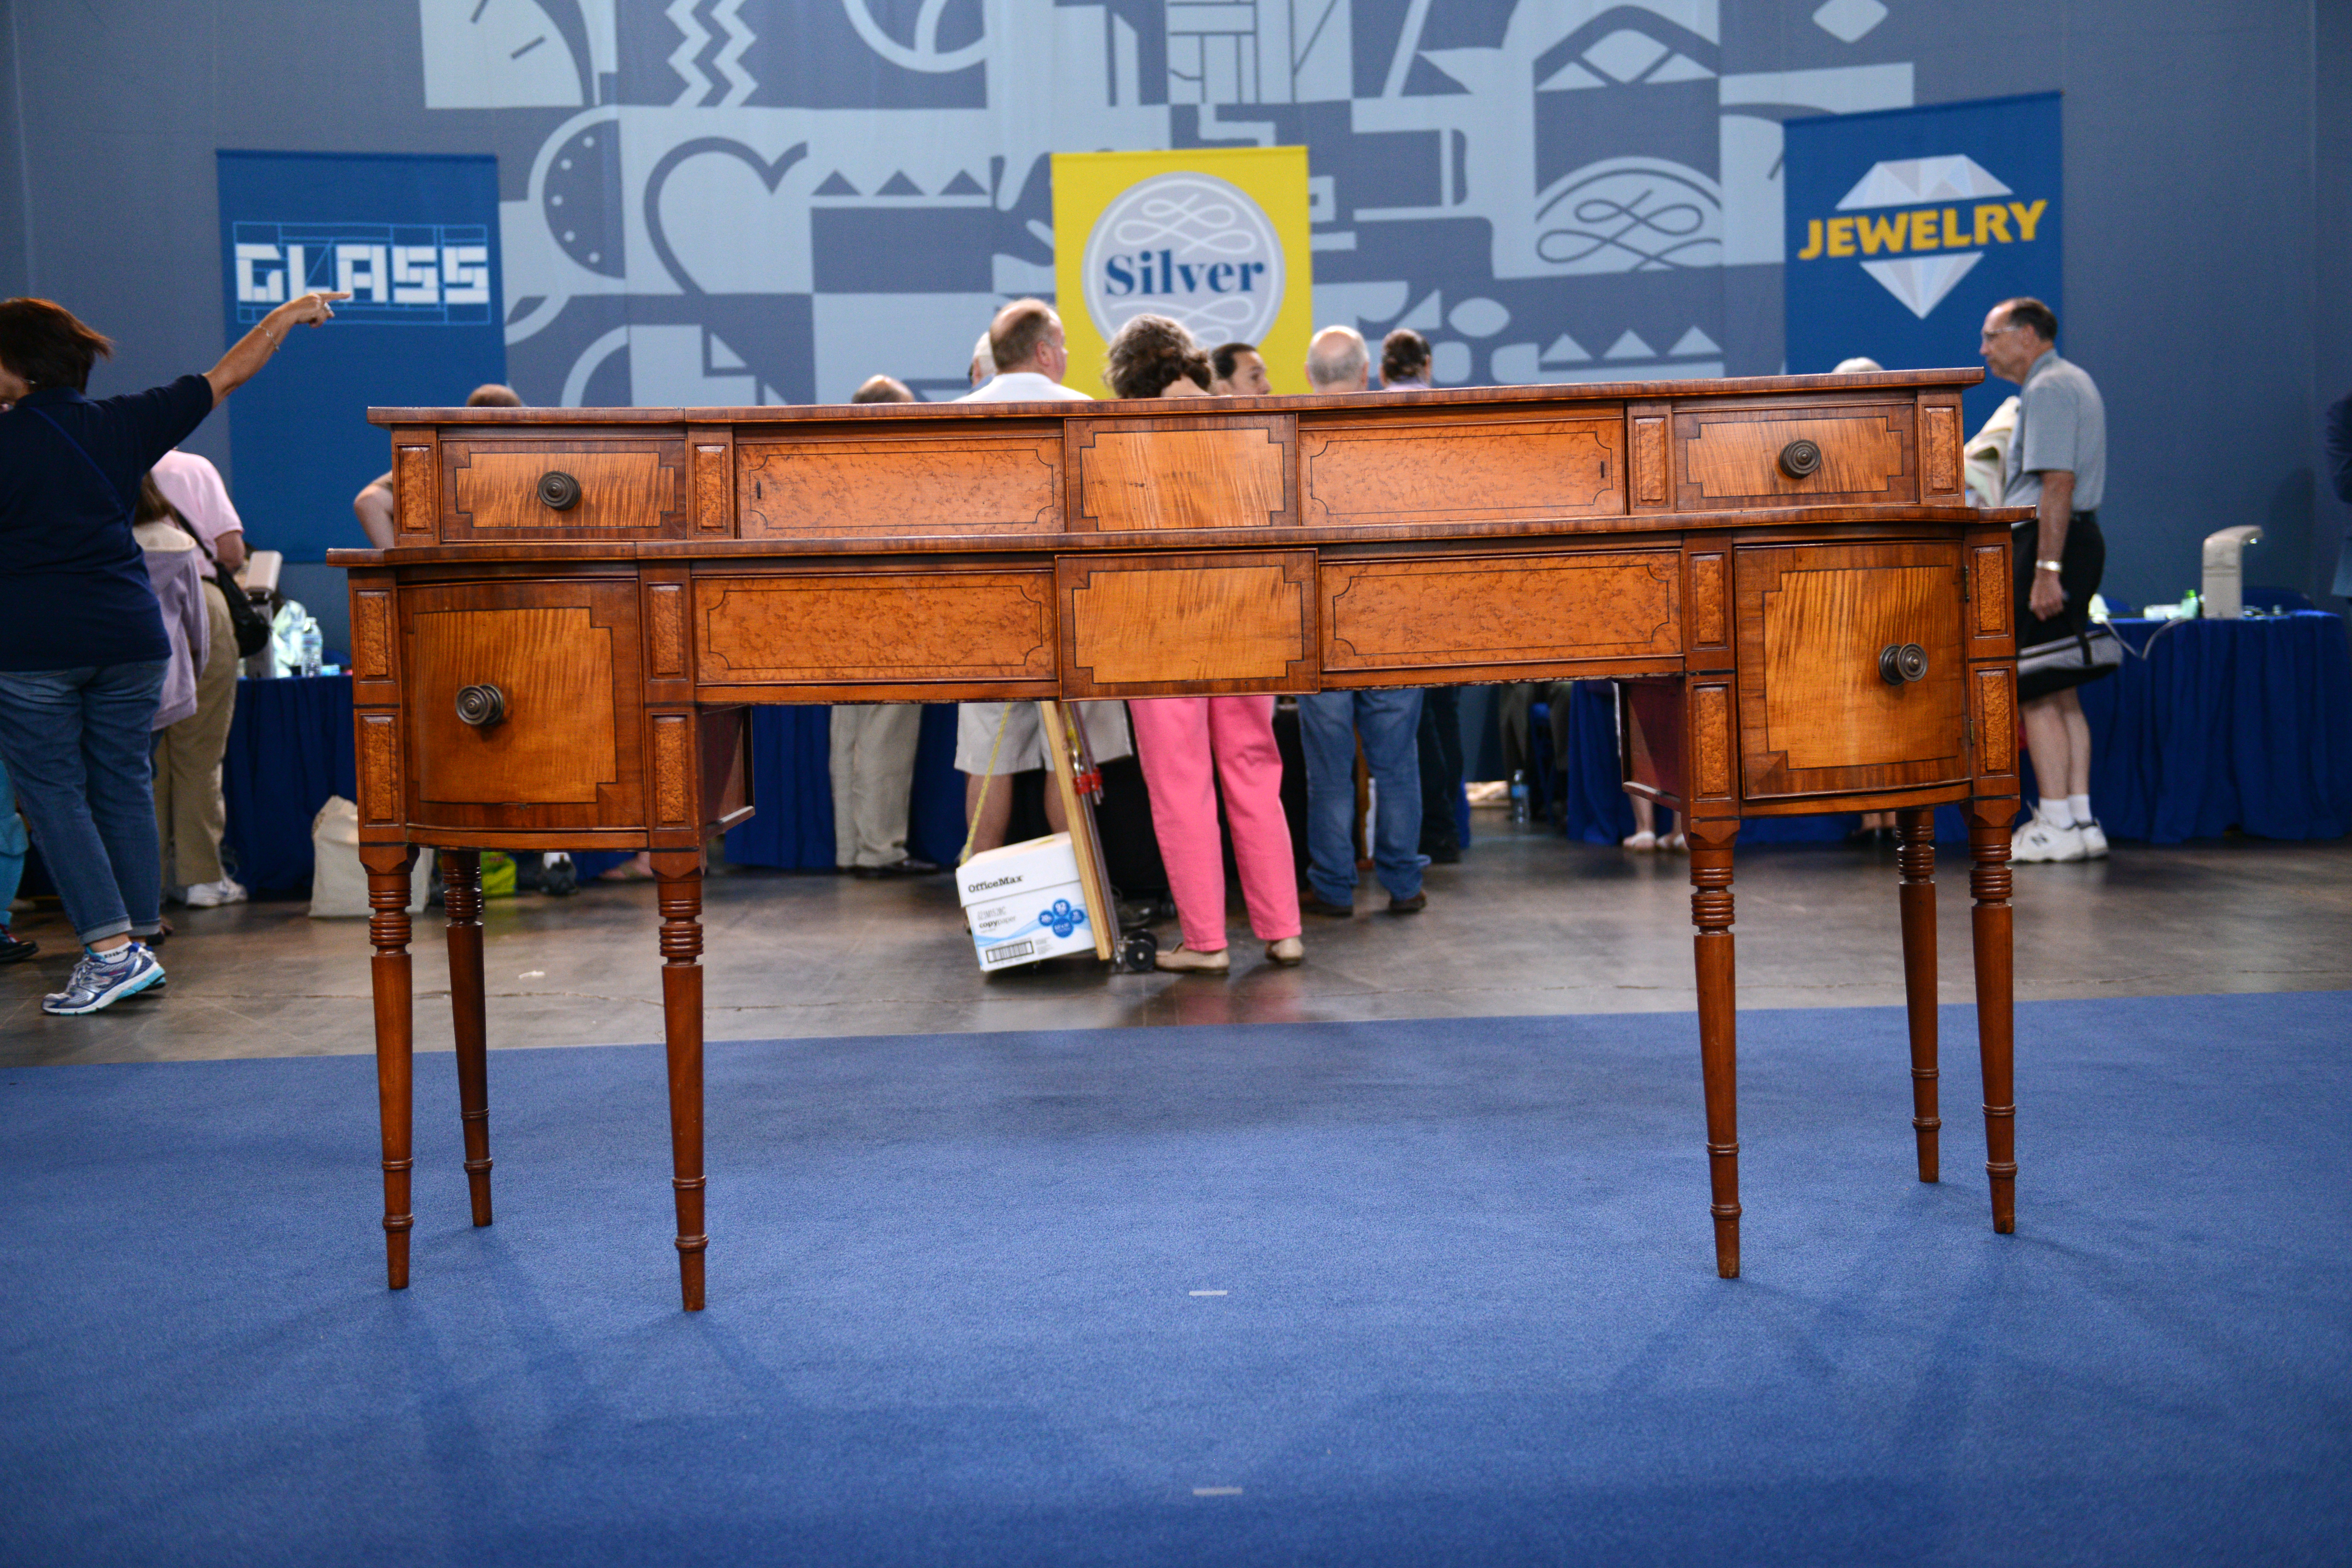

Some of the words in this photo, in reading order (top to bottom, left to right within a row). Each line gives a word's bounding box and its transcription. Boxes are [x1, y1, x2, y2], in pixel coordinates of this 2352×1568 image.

[1798, 199, 2048, 260] JEWELRY
[235, 243, 490, 304] GLASS
[1105, 249, 1265, 296] Silver
[968, 875, 1023, 893] OfficeMax
